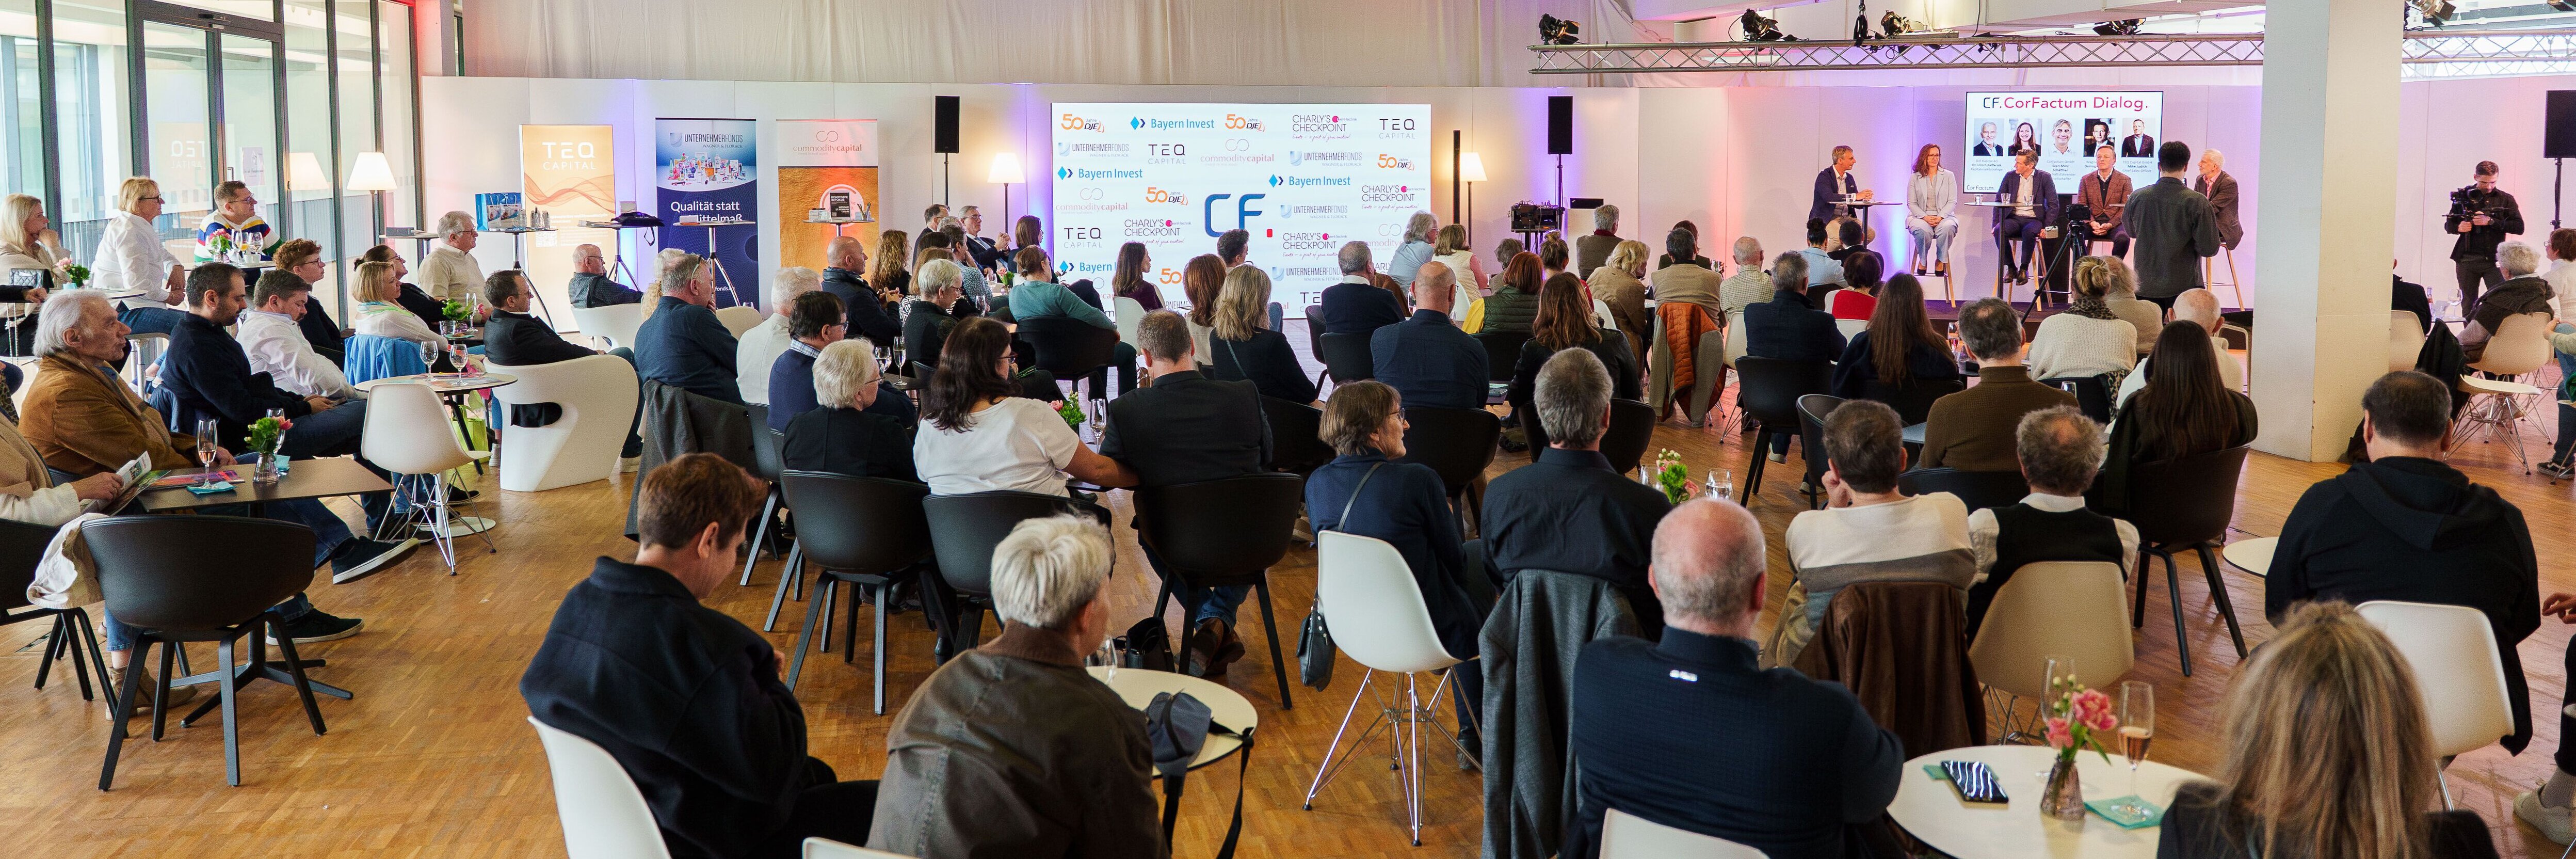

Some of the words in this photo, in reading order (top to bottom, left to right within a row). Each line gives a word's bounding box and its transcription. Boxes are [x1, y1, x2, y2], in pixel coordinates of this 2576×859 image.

[2094, 97, 2148, 112] Dialog.
[1061, 114, 1084, 130] 50
[1151, 119, 1184, 130] Bayern
[1187, 119, 1214, 128] Invest
[1225, 114, 1246, 129] 50
[1292, 115, 1330, 123] CHARLY'S
[1379, 119, 1415, 130] TEQ
[684, 134, 743, 143] UNTERNEHMERFONDS
[542, 141, 595, 159] TEQ
[793, 145, 862, 153] commoditycapital
[1072, 144, 1129, 152] UNTERNEHMERFONDS
[1148, 145, 1186, 156] TEQ
[1200, 154, 1274, 164] commoditycapital
[1378, 154, 1397, 168] 50
[543, 162, 597, 170] CAPITAL
[1078, 168, 1112, 180] Bayern
[1115, 168, 1142, 178] Invest
[1289, 177, 1321, 188] Bayern
[1323, 177, 1351, 185] Invest
[1362, 185, 1399, 193] CHARLY'S
[1146, 187, 1168, 203] 50
[671, 201, 714, 213] Qualität
[716, 201, 740, 211] statt
[1056, 202, 1128, 212] commoditycapital
[1293, 205, 1348, 214] UNTERNEHMERFONDS
[1124, 219, 1164, 227] CHARLY'S
[1064, 228, 1102, 240] TEQ
[1124, 228, 1180, 236] CHECKPOINT
[1283, 242, 1337, 250] CHECKPOINT
[1080, 262, 1112, 274] Bayern
[1286, 267, 1342, 276] UNTERNEHMERFOND
[1160, 268, 1182, 284] 50
[1300, 292, 1321, 304] TE
